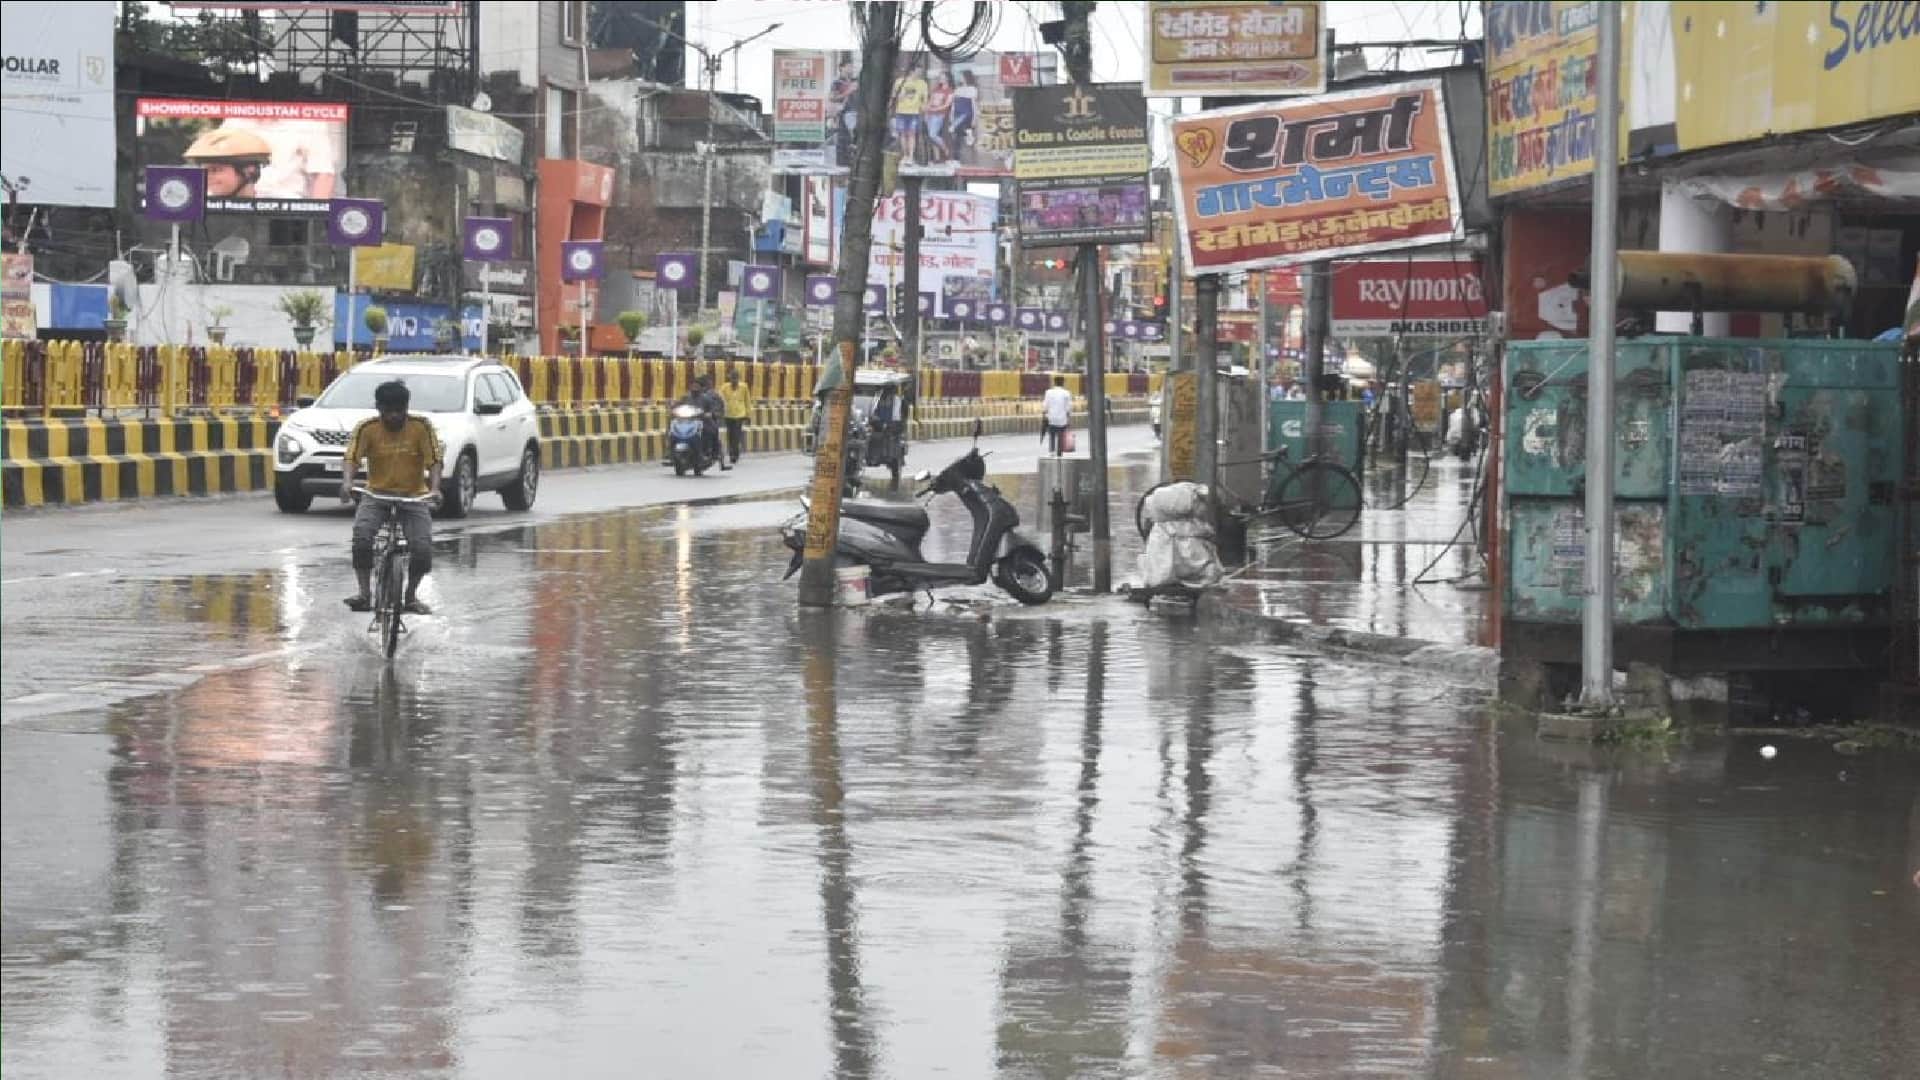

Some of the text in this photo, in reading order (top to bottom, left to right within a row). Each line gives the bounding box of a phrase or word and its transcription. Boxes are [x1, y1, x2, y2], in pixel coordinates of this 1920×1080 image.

[1, 56, 60, 75] OLLAR
[141, 102, 346, 118] SHOWROOM HINDUSTAN CYCLE
[1108, 125, 1144, 139] Events
[1221, 93, 1423, 172] शर्मा
[388, 308, 418, 337] vivo
